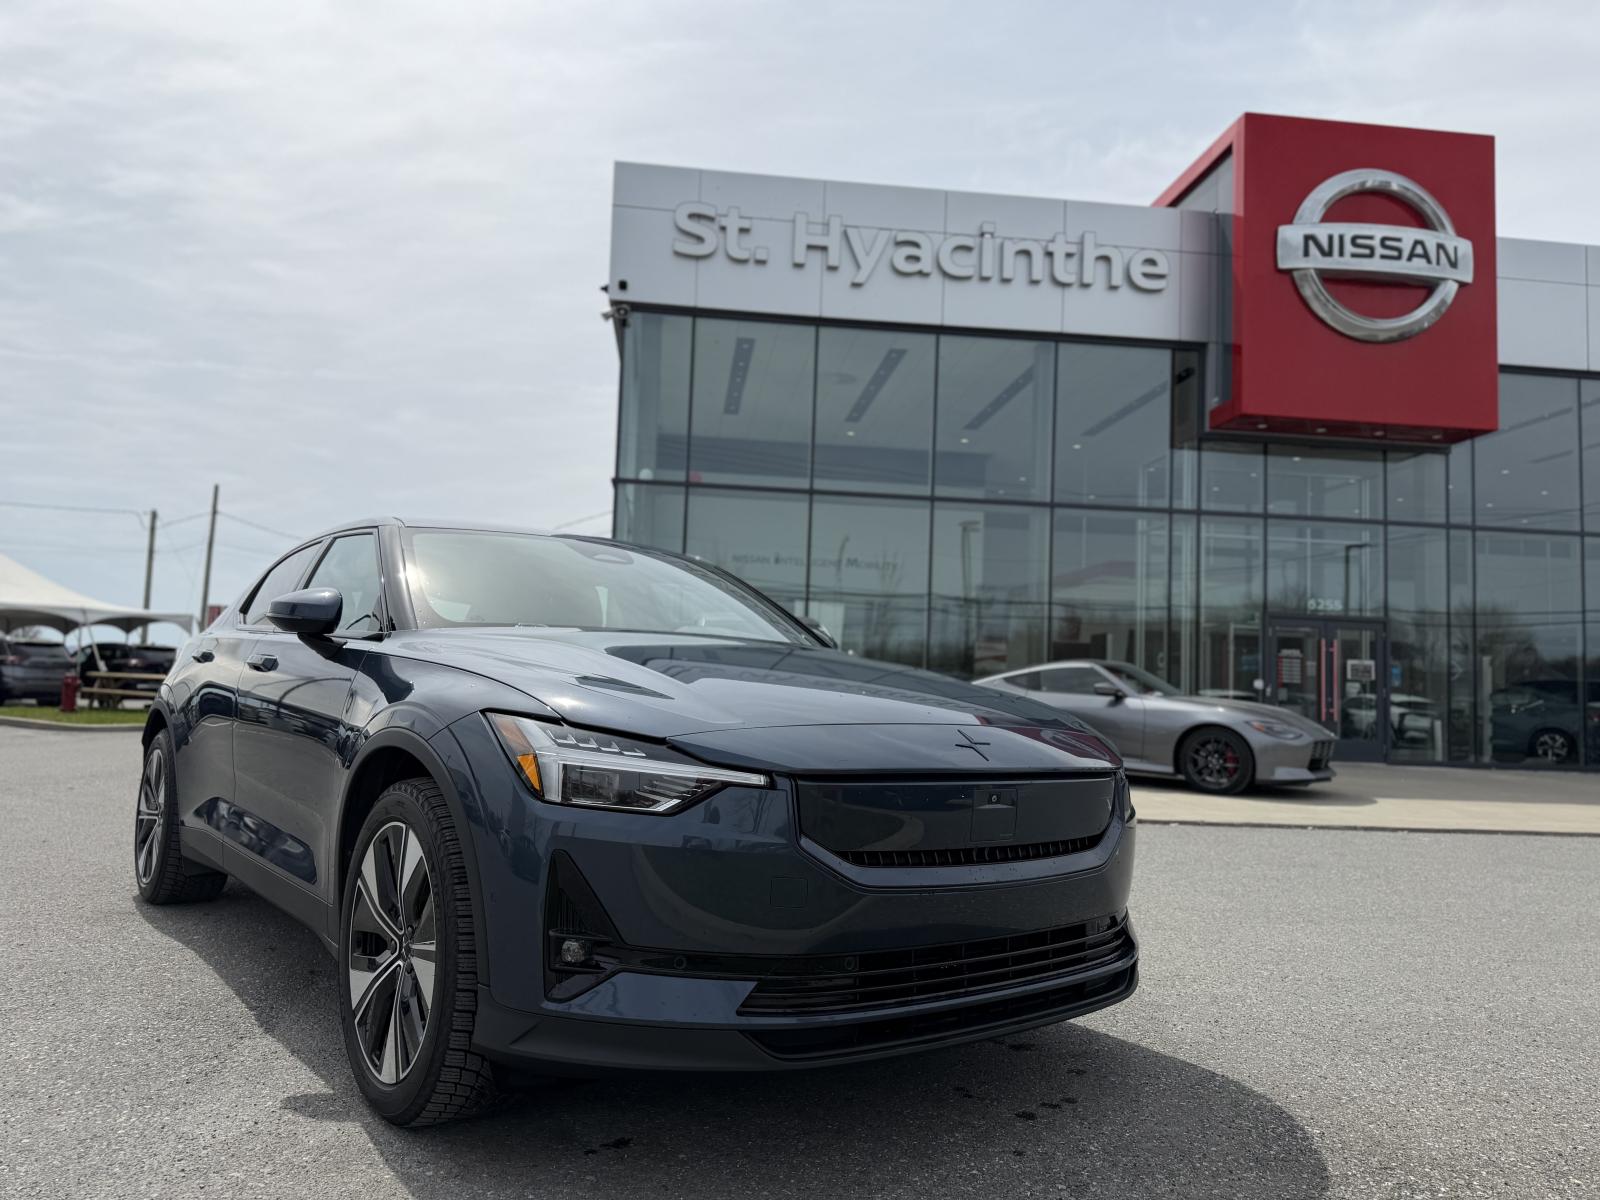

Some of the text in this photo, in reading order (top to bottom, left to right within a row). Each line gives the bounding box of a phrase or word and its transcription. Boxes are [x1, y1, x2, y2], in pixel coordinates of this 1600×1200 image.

[673, 202, 1170, 291] St. Hyacinthe
[1303, 233, 1459, 270] NISSAN
[1307, 598, 1343, 611] 6255
